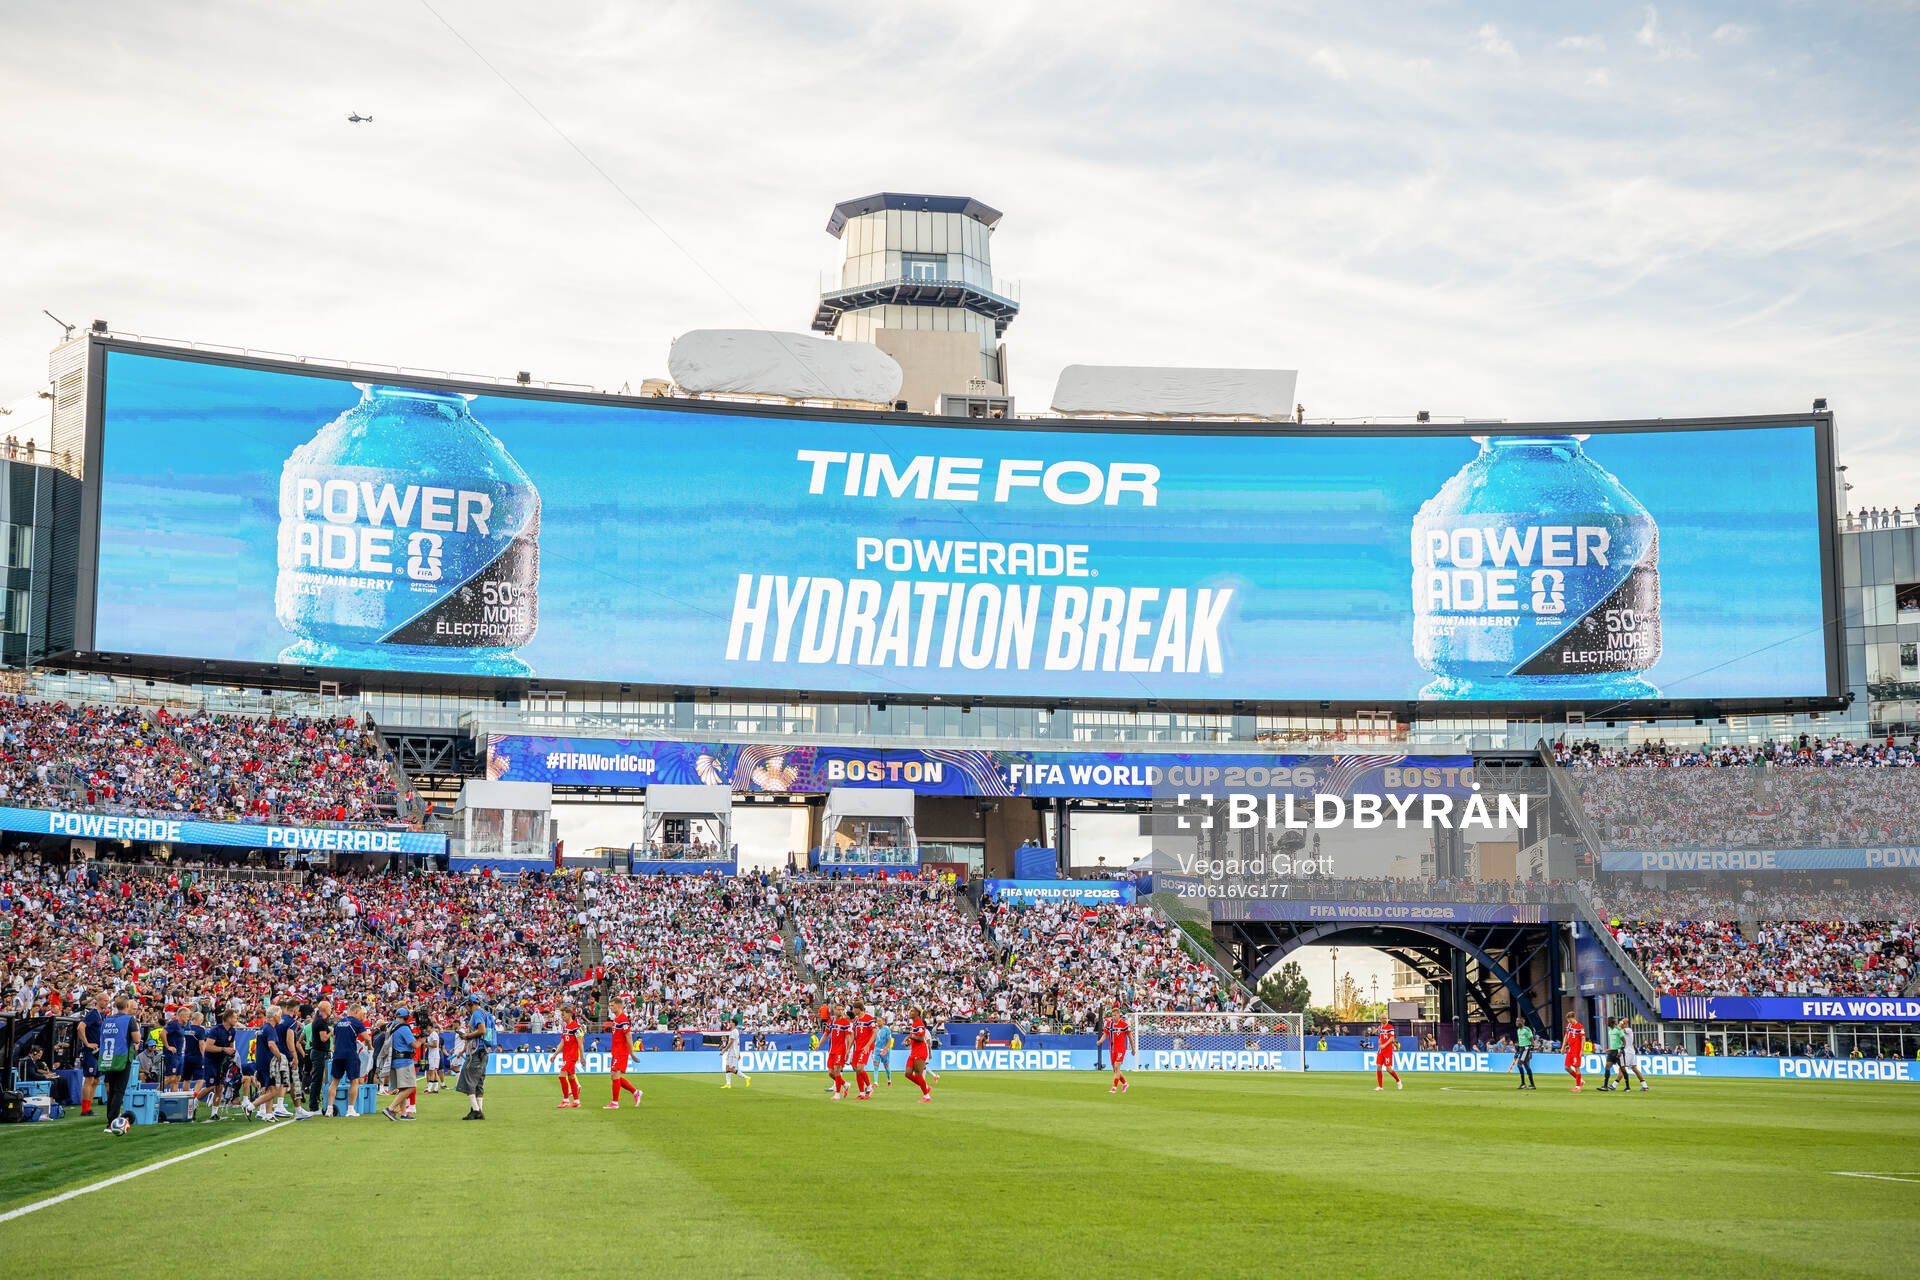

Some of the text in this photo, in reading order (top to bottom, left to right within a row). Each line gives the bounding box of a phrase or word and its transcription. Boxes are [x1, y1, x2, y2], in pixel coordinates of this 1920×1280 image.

[797, 449, 1161, 506] TIME FOR
[297, 478, 493, 536] POWER
[1427, 526, 1612, 568] POWER
[350, 578, 394, 591] BERRY
[482, 581, 525, 605] 50%
[484, 606, 525, 623] MORE
[725, 574, 1234, 674] HYDRATION BREAK
[1480, 616, 1520, 627] BERRY
[1605, 609, 1649, 632] 50%
[1608, 632, 1649, 649] MORE
[546, 752, 655, 775] #FIFAWorldCup
[828, 759, 942, 783] BOSTON
[1010, 763, 1317, 787] FIFA WORLD CUP 2026
[50, 811, 181, 842] POWERADE
[267, 827, 401, 851] POWERADE
[1642, 850, 1777, 870] POWERADE
[1001, 888, 1120, 898] FIFA WORLD CUP 2026
[1310, 906, 1455, 918] FIFA WORLD CUP 2026
[1803, 1002, 1920, 1018] FIFA WORLD
[941, 1050, 1071, 1070] POWERADE
[1155, 1051, 1285, 1070] POWERADE
[1364, 1052, 1489, 1072] PWERADE
[1780, 1059, 1910, 1080] POWERADE
